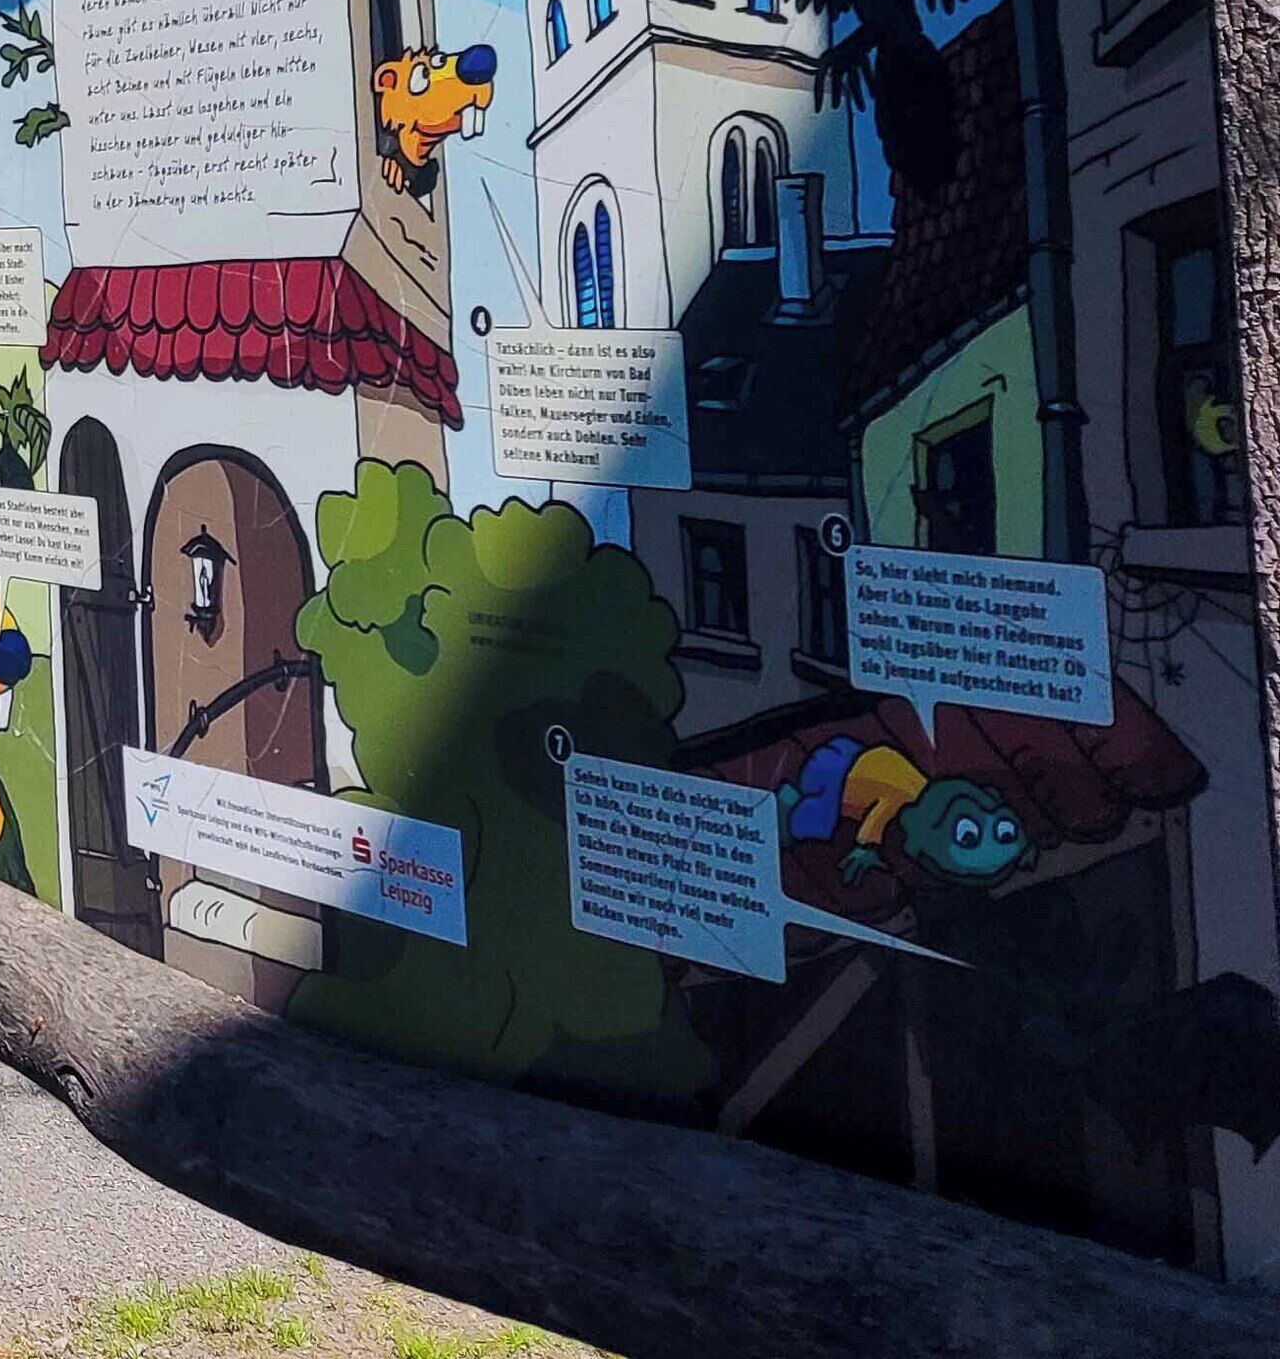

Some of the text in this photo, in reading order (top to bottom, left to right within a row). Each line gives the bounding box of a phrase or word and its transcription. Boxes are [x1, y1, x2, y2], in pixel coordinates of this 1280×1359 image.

[83, 25, 113, 39] räume
[141, 21, 153, 31] es
[159, 7, 197, 30] nämlich
[85, 52, 102, 75] für
[107, 49, 121, 67] die
[229, 31, 246, 49] mit
[282, 23, 322, 45] sechs,
[116, 78, 148, 94] Beinen
[153, 69, 171, 89] und
[176, 67, 191, 85] mit
[197, 66, 236, 92] Flügeln
[241, 59, 271, 79] leben
[277, 56, 316, 73] mitten
[89, 108, 116, 124] unter
[177, 104, 193, 116] uns
[199, 94, 245, 122] losgehen
[251, 88, 269, 109] und
[275, 89, 292, 107] ein
[134, 135, 180, 159] genauer
[184, 125, 202, 146] und
[205, 122, 266, 152] geduldiger
[91, 163, 133, 180] schauen
[204, 155, 229, 174] erst
[234, 151, 268, 171] recht
[273, 149, 318, 176] später
[93, 185, 209, 214] in der Dämmerung und
[495, 341, 656, 359] Tatsächlich dann ist es also
[529, 363, 651, 381] Am Kirchturm von Bad
[499, 384, 531, 398] Düben
[534, 385, 565, 399] leben
[568, 387, 595, 401] nicht
[598, 391, 617, 401] nur
[540, 408, 609, 425] Mauersegler
[610, 411, 633, 424] und
[501, 425, 544, 440] sondern
[547, 429, 572, 442] auch
[621, 431, 647, 447] Sehr
[503, 448, 542, 462] seltene
[880, 561, 908, 580] hier
[952, 570, 987, 589] mich
[858, 585, 981, 612] Aber ich kann das
[906, 615, 1084, 651] Warum eine Fledermaus
[896, 639, 1087, 677] tagsüber hier Ob
[861, 658, 1082, 704] sie jemand aufgeschreckt hat?
[611, 774, 639, 793] kann
[641, 781, 659, 798] ich
[726, 800, 754, 817] aber
[378, 850, 454, 888] Sparkasse
[380, 878, 433, 915] Leipzig
